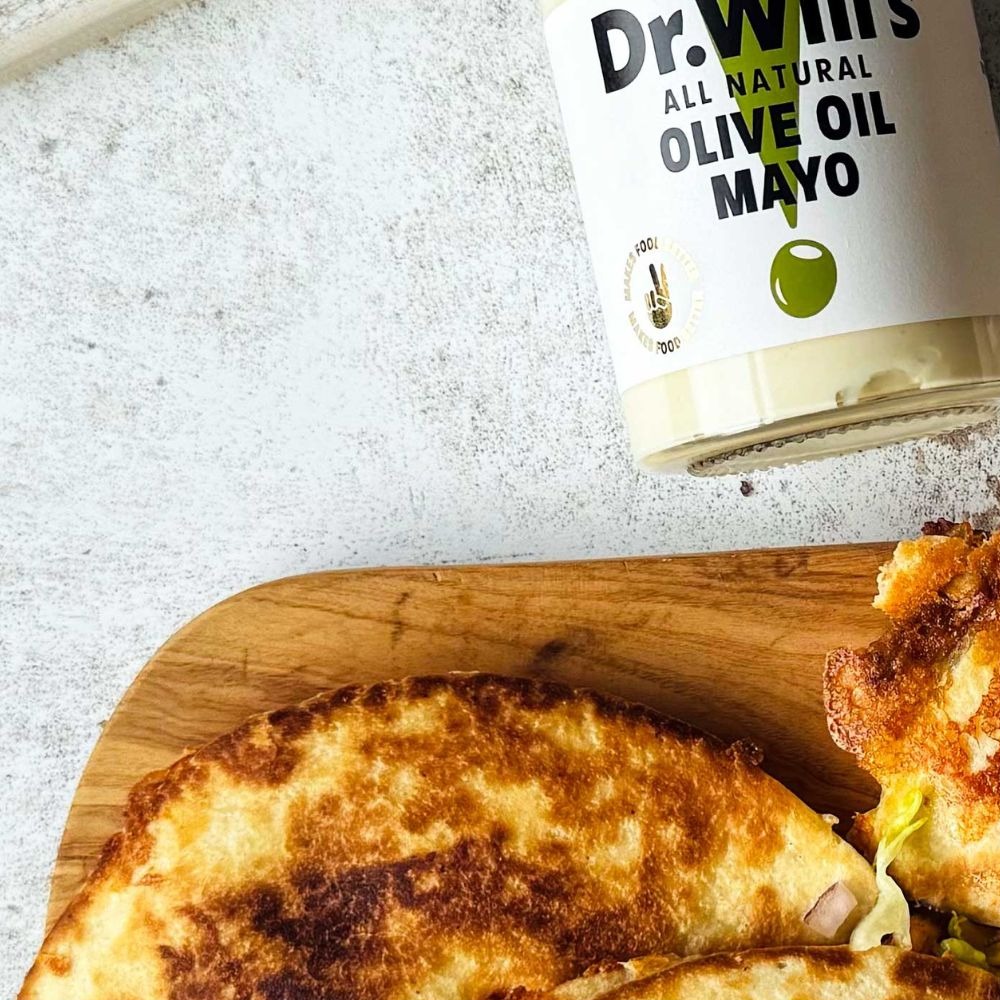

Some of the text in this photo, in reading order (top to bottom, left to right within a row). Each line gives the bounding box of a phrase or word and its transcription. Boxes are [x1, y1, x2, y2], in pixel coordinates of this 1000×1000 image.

[664, 54, 872, 114] ALL NATURAL
[660, 91, 896, 173] OLIVE OIL
[711, 152, 859, 220] MAYO
